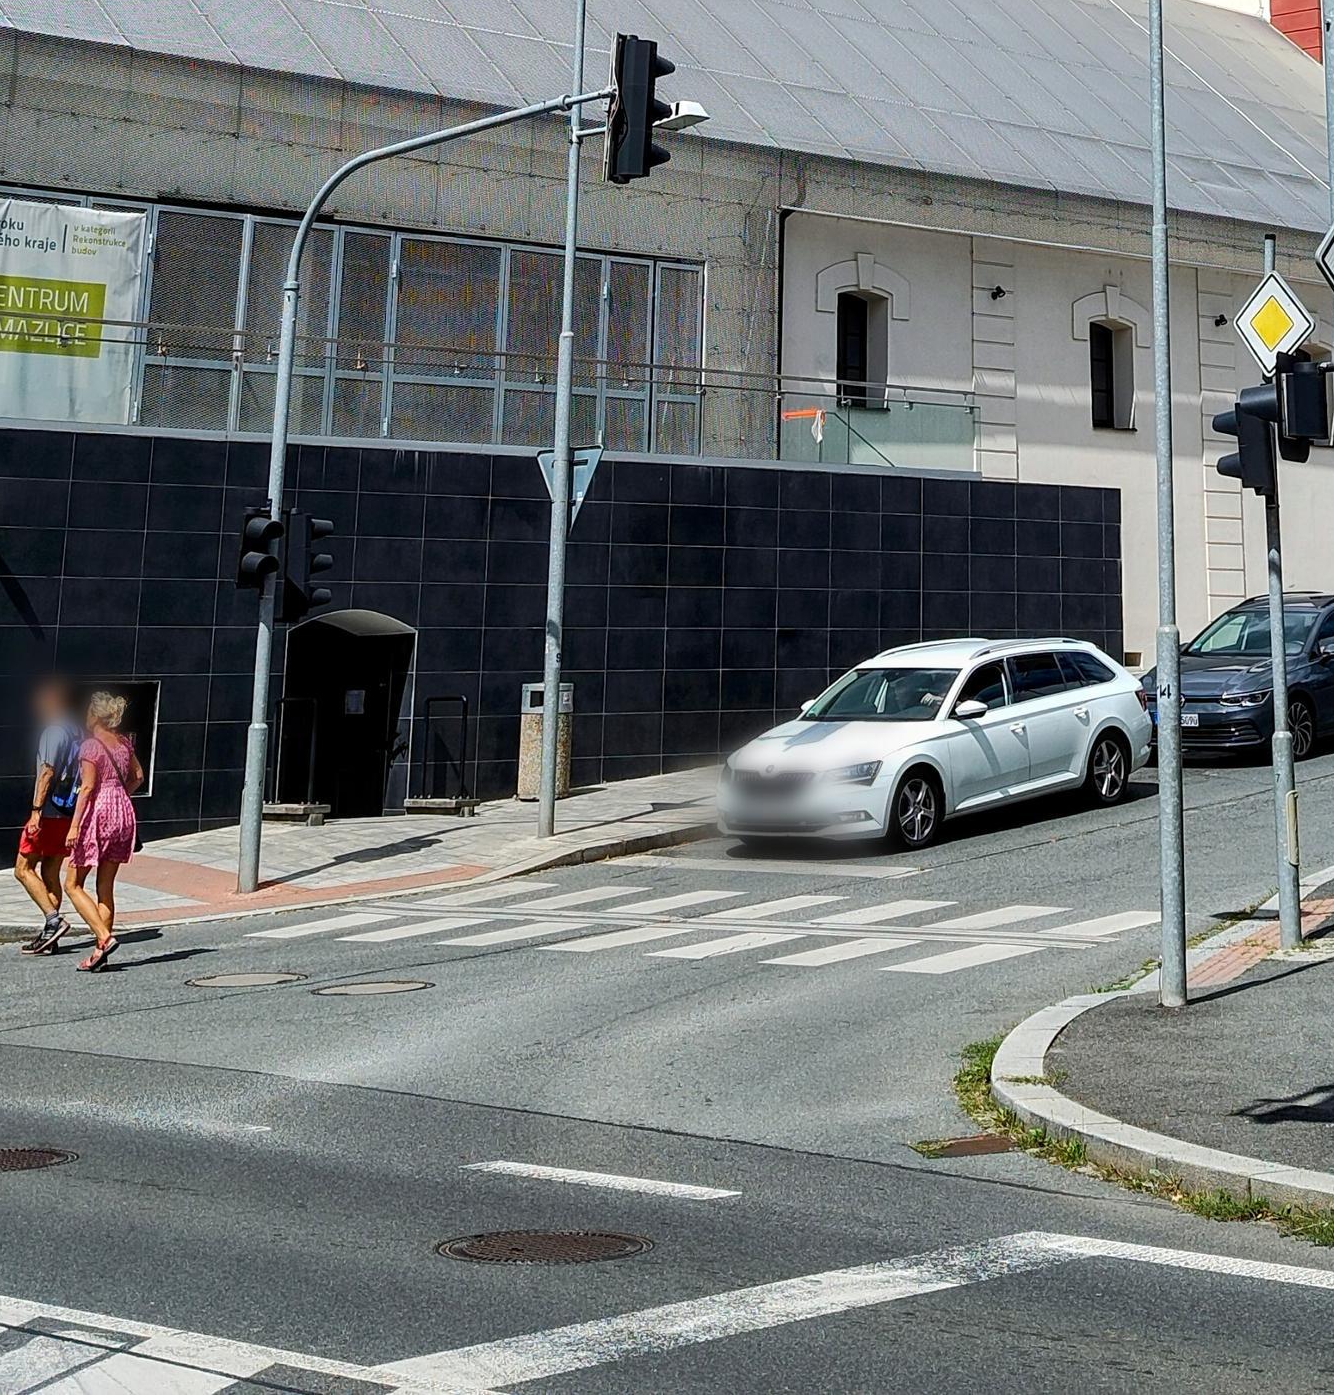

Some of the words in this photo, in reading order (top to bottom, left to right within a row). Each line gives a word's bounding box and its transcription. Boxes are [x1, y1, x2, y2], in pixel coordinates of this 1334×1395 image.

[25, 235, 57, 253] kraje
[72, 235, 127, 248] Rekonstrukce
[71, 246, 98, 256] budov
